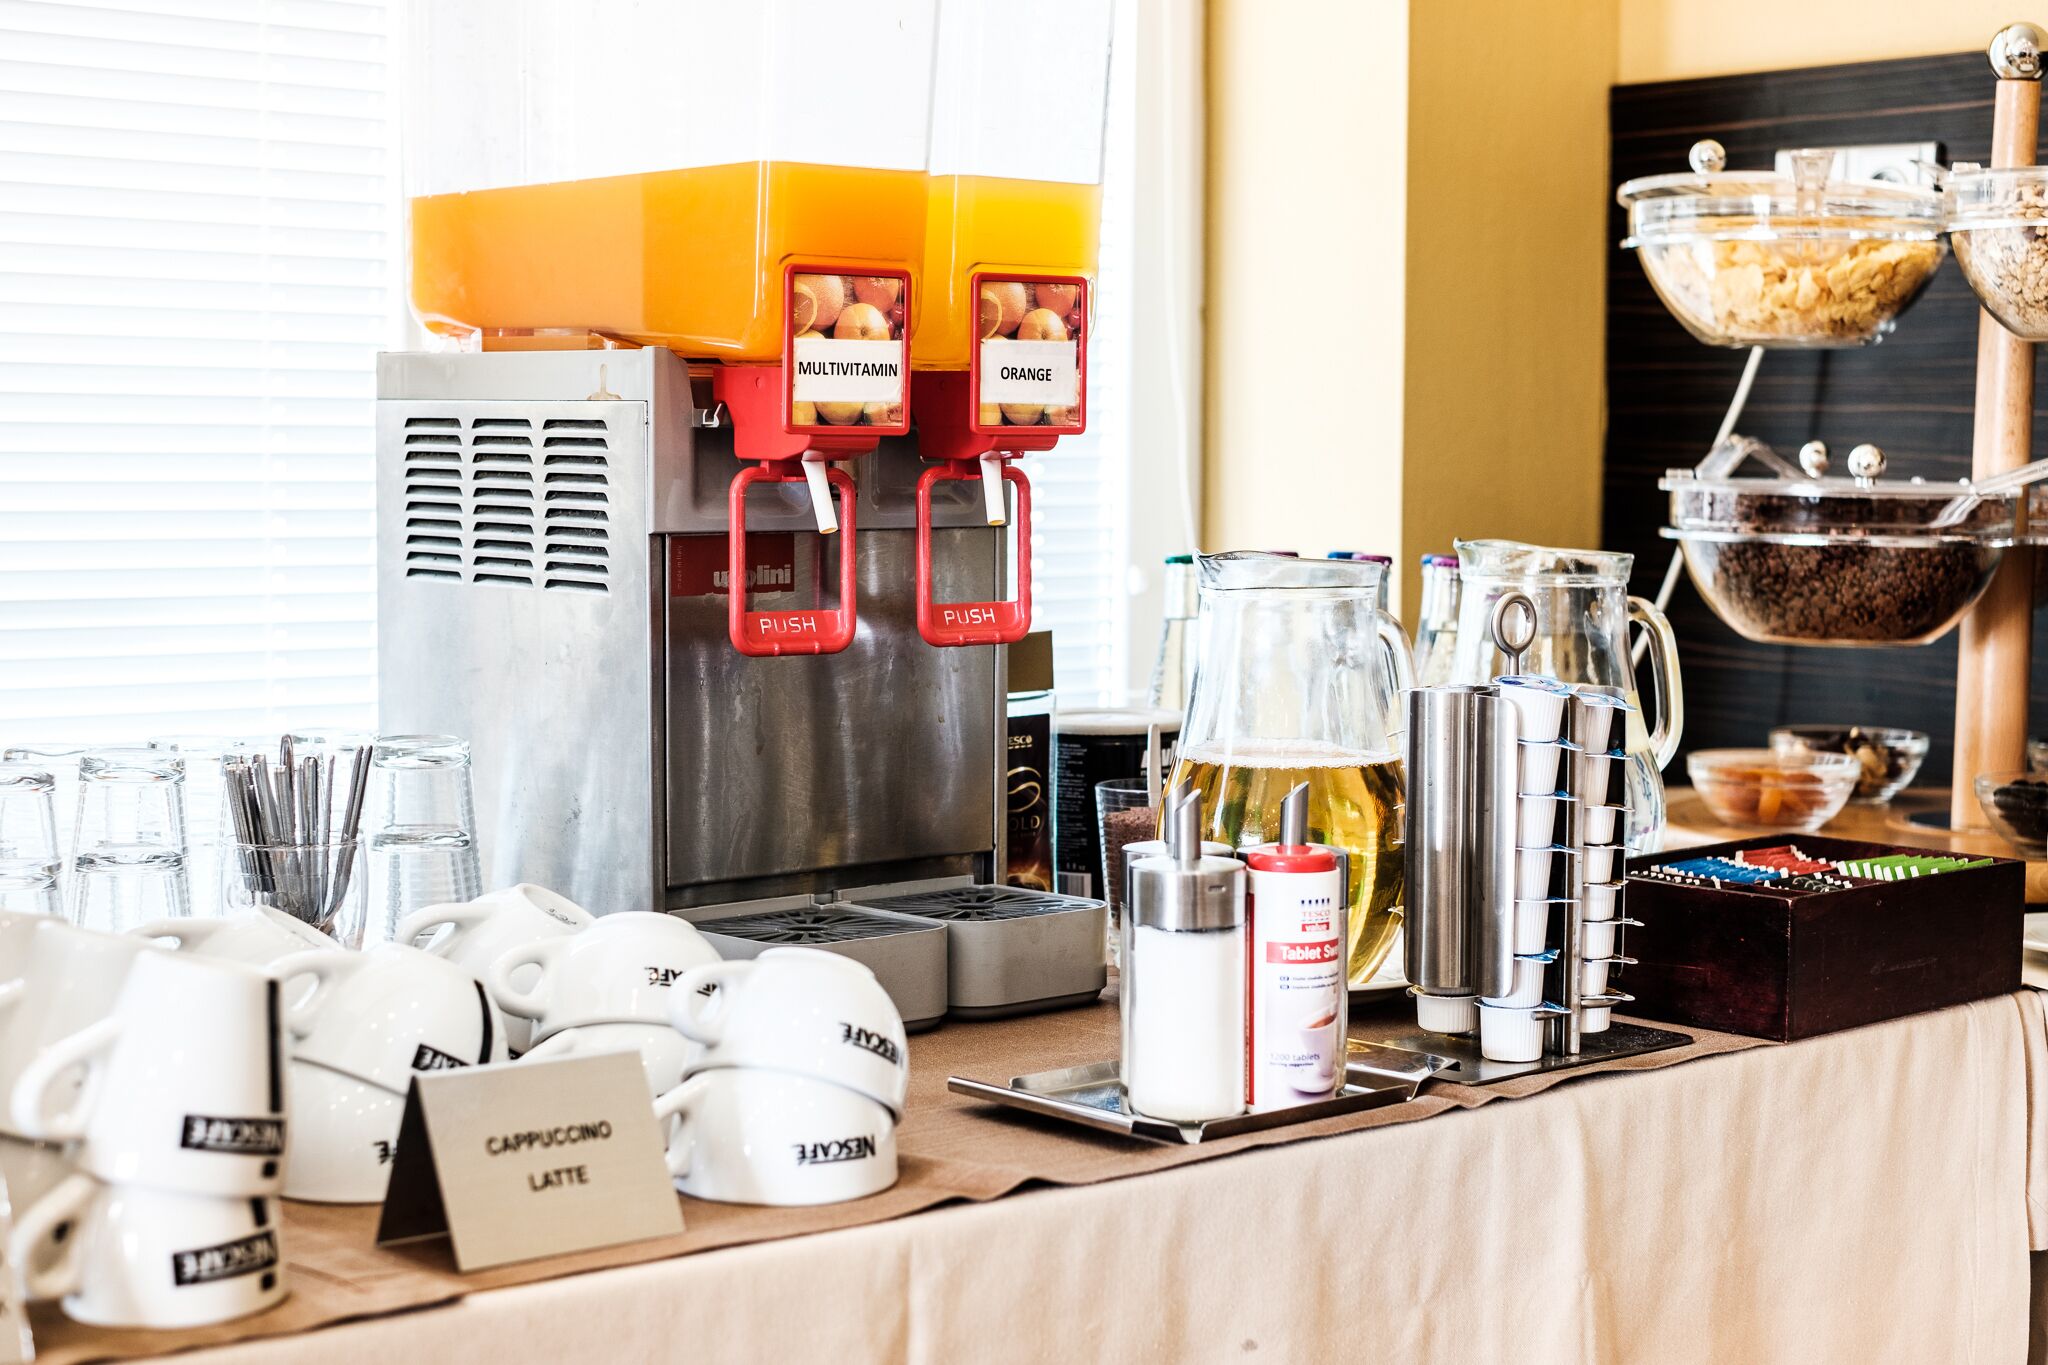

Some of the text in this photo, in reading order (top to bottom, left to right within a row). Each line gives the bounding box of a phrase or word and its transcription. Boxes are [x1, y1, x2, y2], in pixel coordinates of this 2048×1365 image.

[798, 361, 898, 378] MULTIVITAMIN
[1000, 366, 1052, 382] ORANGE
[713, 564, 791, 588] uolini
[759, 616, 817, 634] PUSH
[943, 608, 996, 625] PUSH
[1008, 735, 1033, 745] ESCO
[1009, 815, 1041, 831] OLD
[1280, 945, 1321, 961] Tablet
[485, 1120, 613, 1156] CAPPUCCINO
[528, 1164, 589, 1193] LATTE
